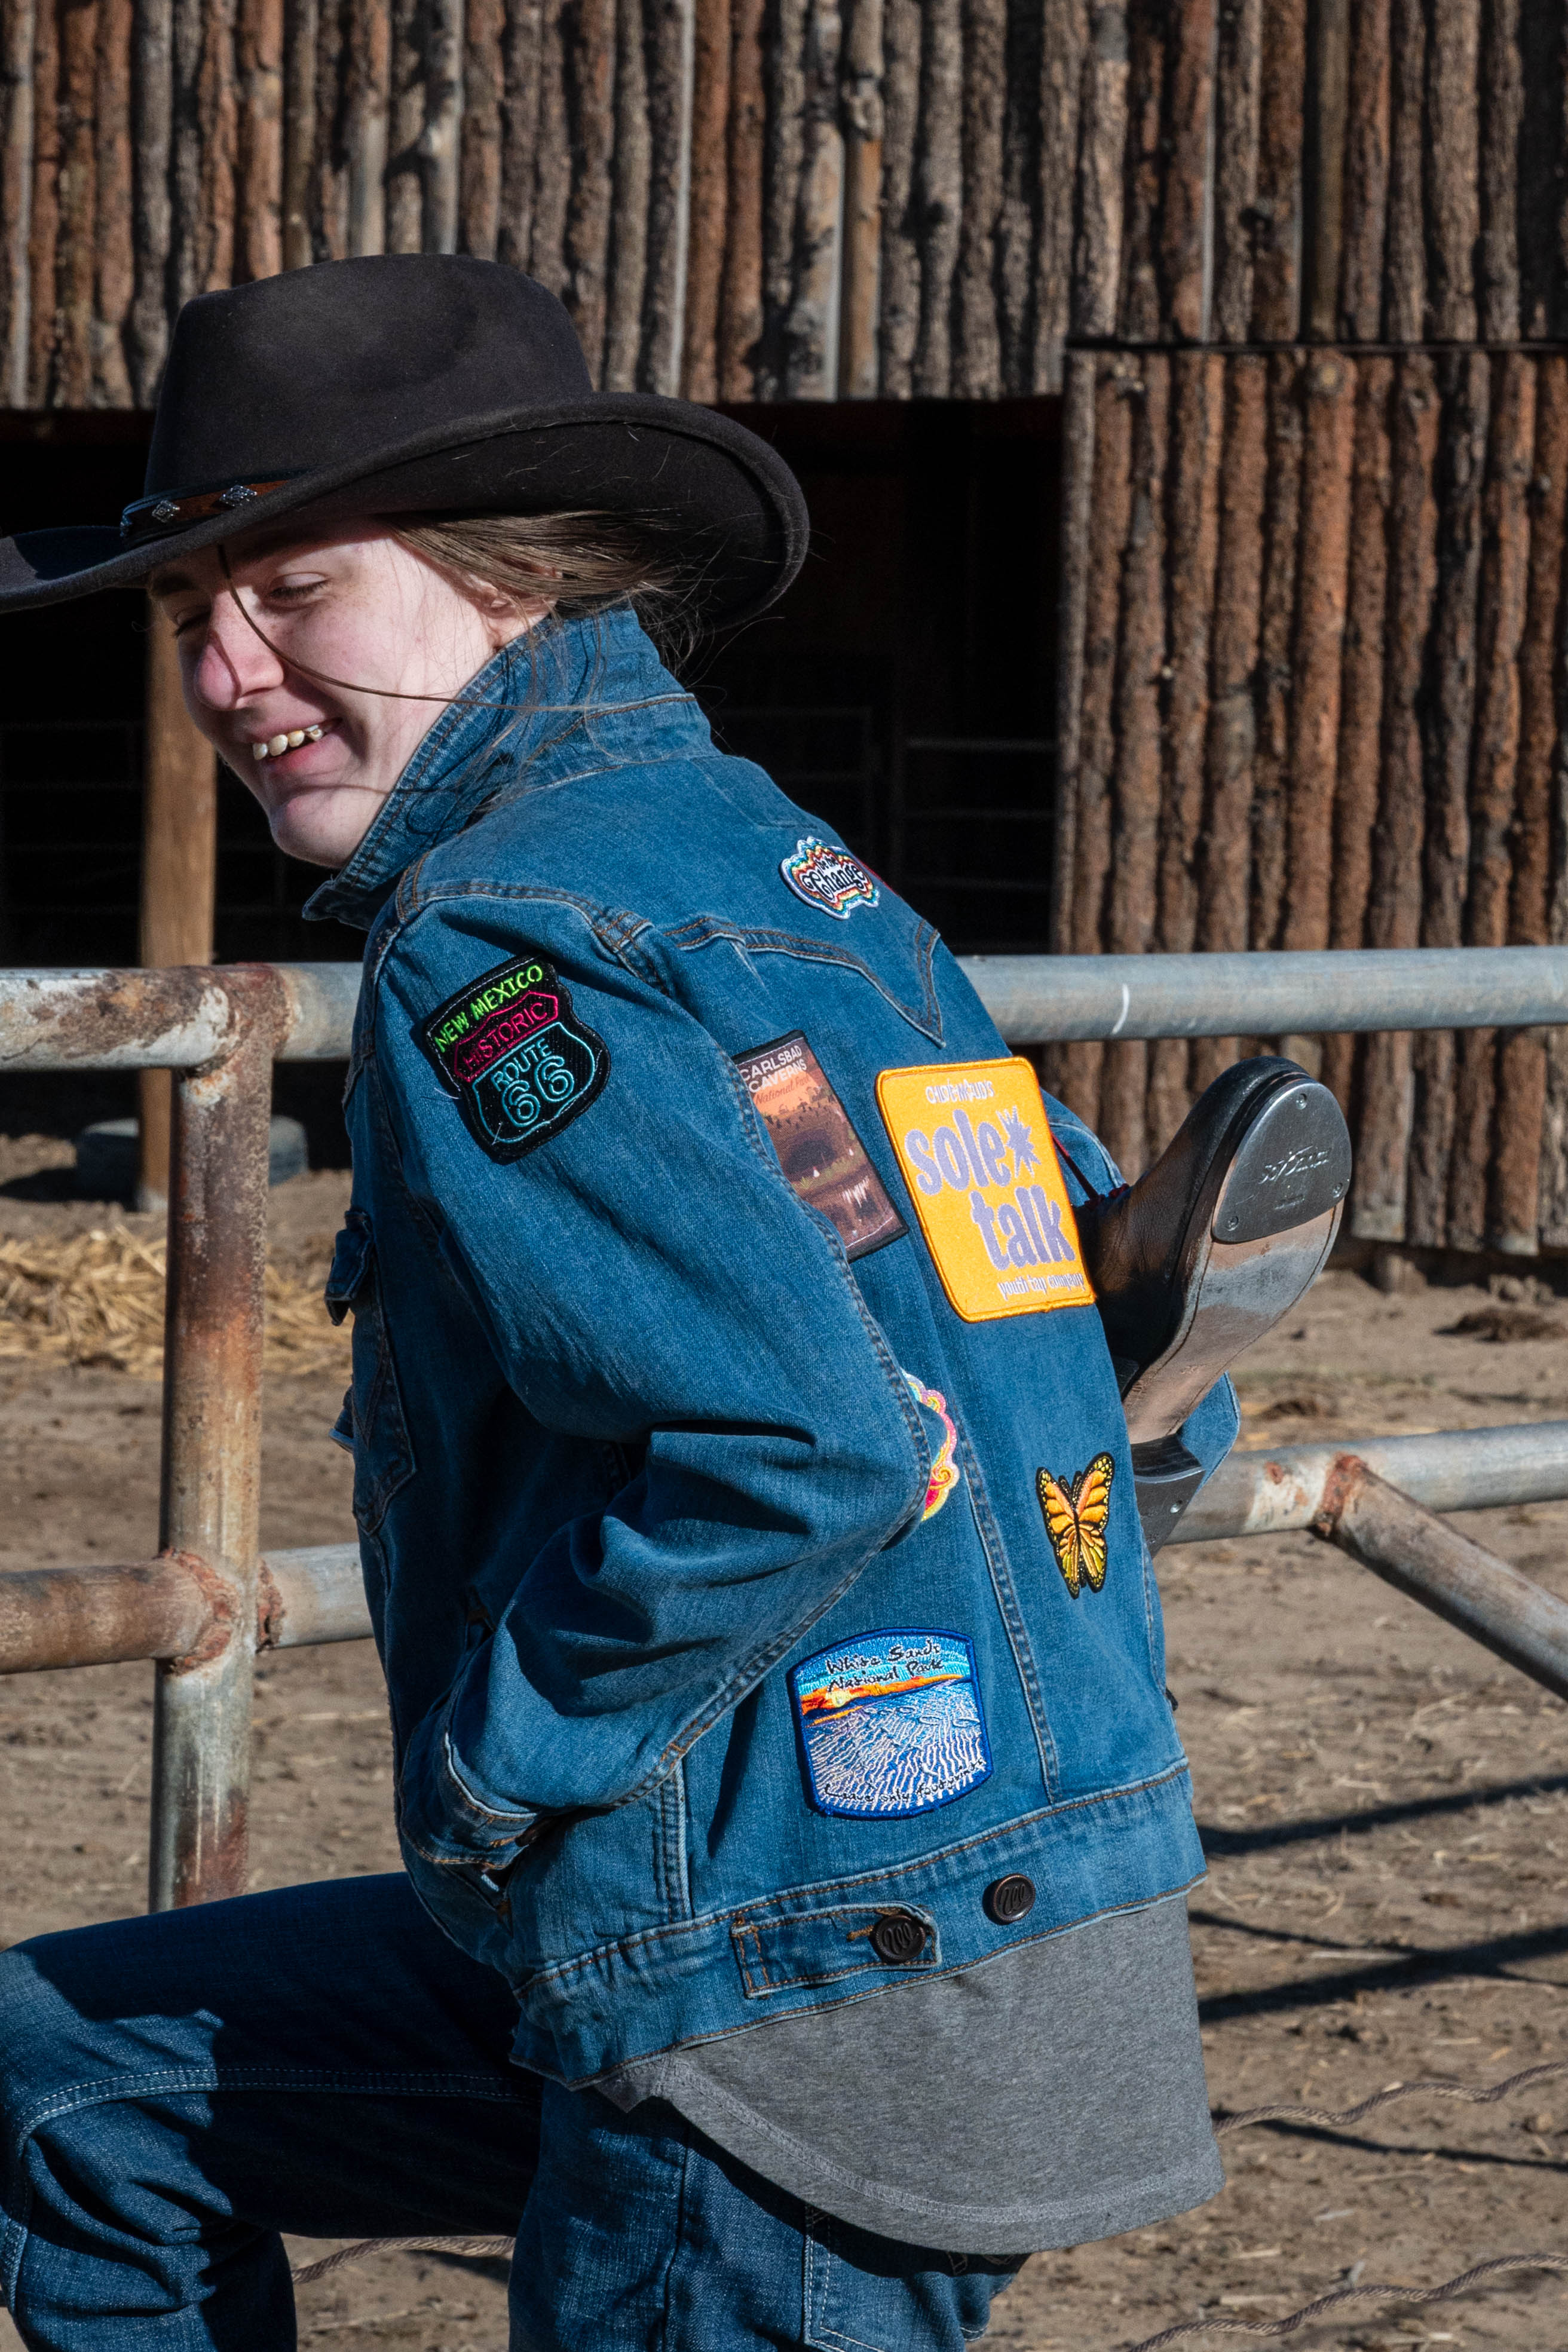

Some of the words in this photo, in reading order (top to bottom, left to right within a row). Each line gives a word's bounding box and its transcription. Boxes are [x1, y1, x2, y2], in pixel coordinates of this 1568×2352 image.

[802, 864, 866, 901] Change
[434, 1011, 469, 1053] NEW
[470, 964, 543, 1021] MEXICO
[463, 1002, 548, 1071] HISTORIC
[491, 1038, 552, 1092] ROUTE
[740, 1045, 803, 1081] CARLSBAD
[749, 1058, 807, 1093] CAVERNS
[502, 1055, 574, 1128] 66
[755, 1080, 795, 1105] National
[969, 1184, 1076, 1271] talk
[997, 1276, 1030, 1301] youth
[1027, 1274, 1048, 1296] tap
[1048, 1272, 1086, 1291] company
[826, 1653, 881, 1674] White
[888, 1639, 941, 1662] Sands
[827, 1666, 899, 1693] National
[906, 1659, 944, 1677] Park
[824, 1783, 874, 1802] Leave
[880, 1788, 910, 1802] only
